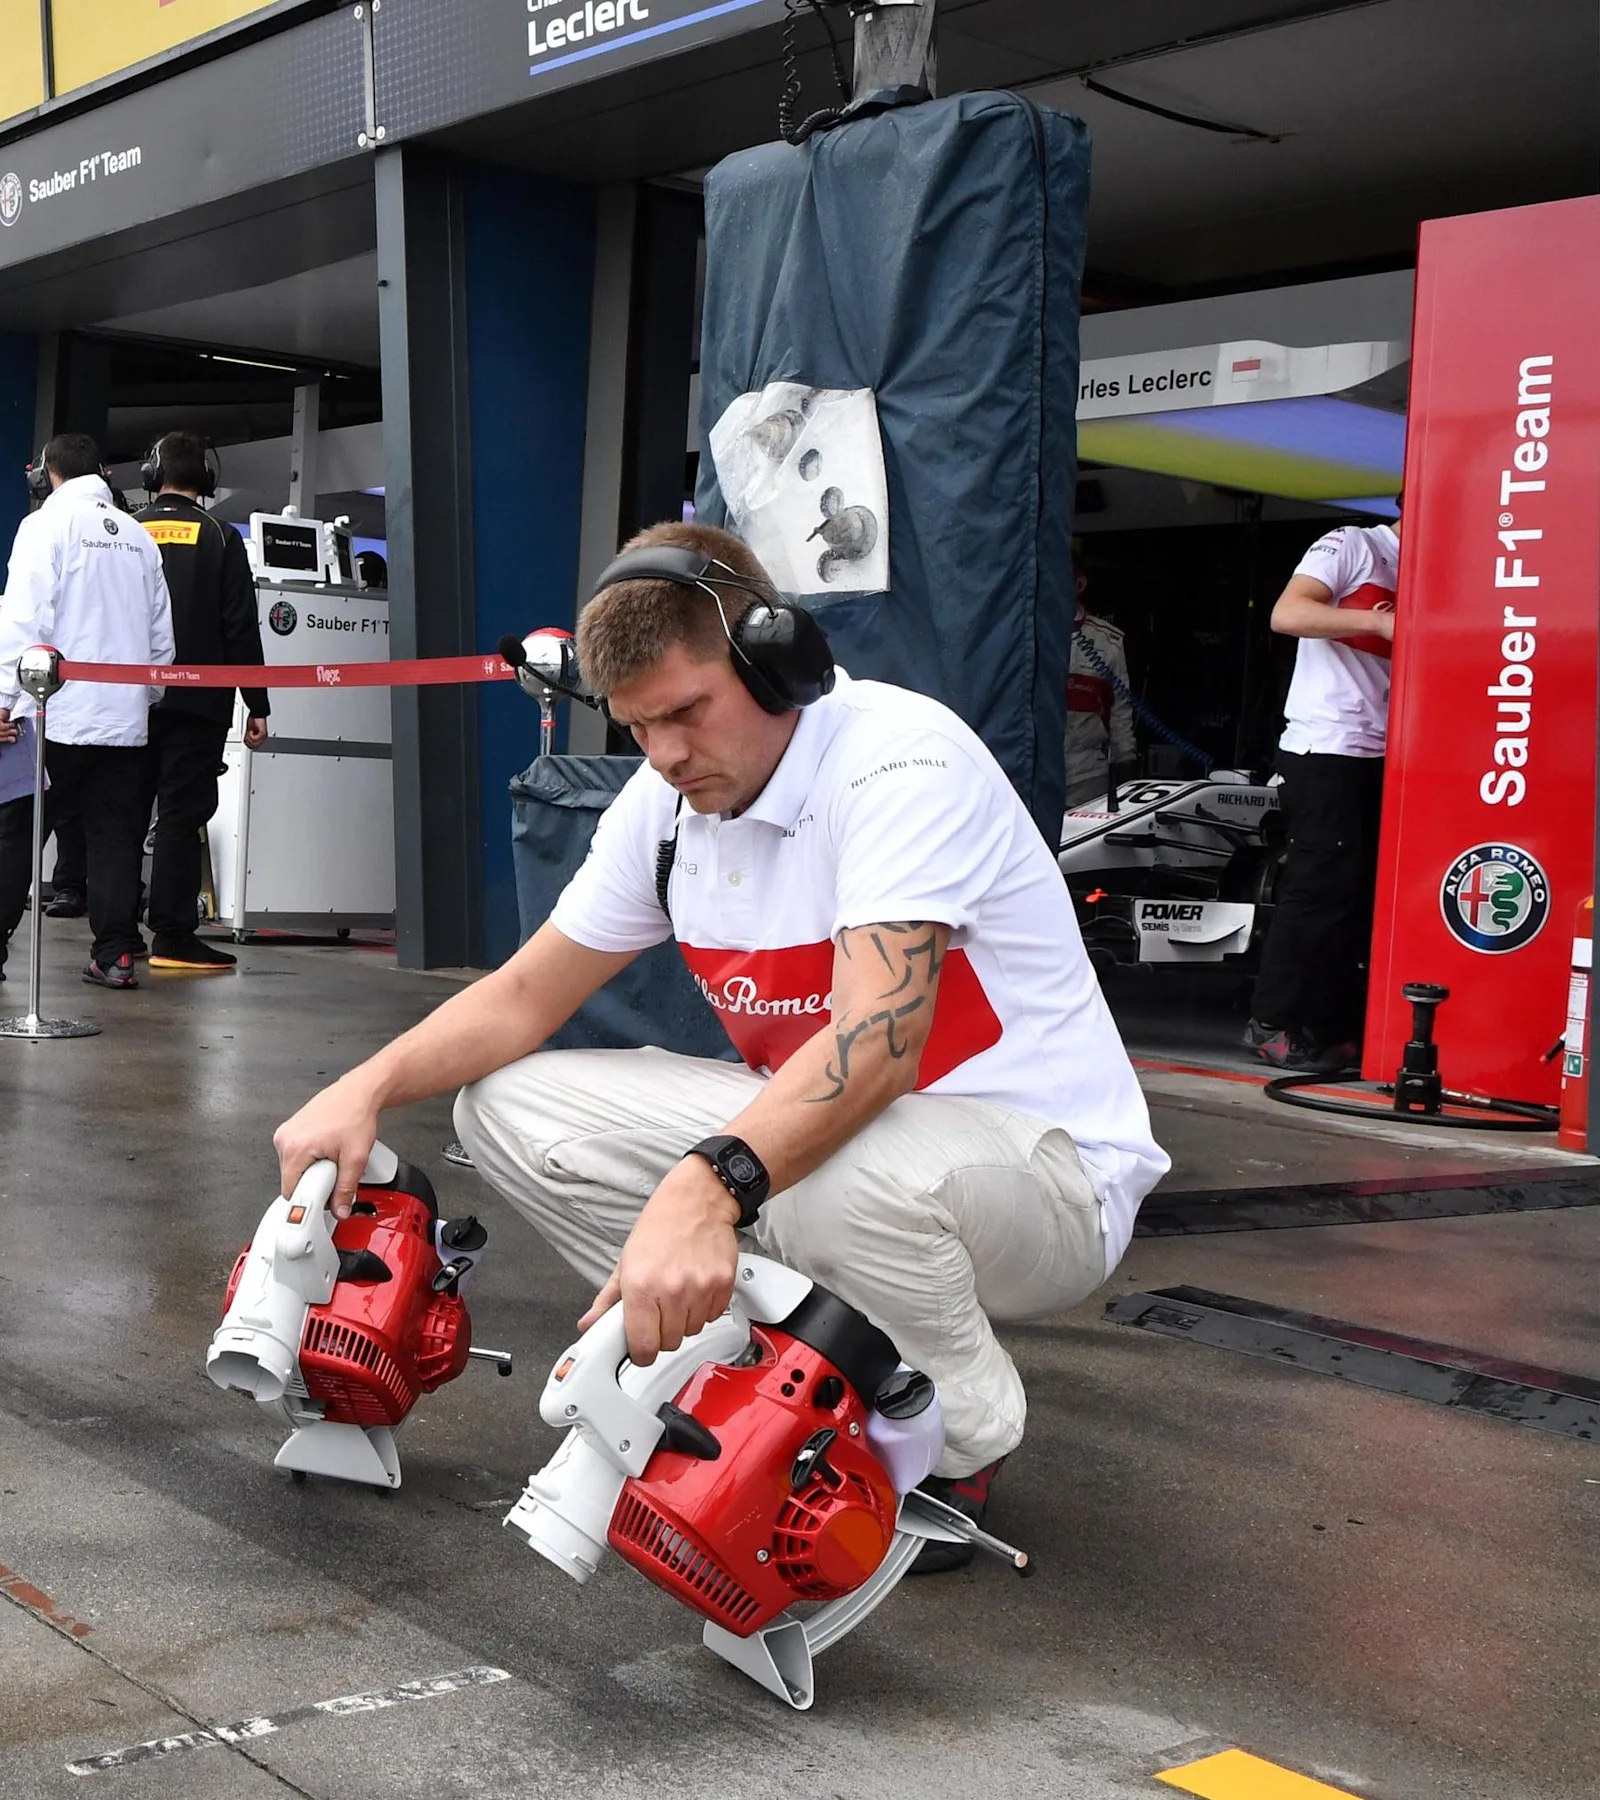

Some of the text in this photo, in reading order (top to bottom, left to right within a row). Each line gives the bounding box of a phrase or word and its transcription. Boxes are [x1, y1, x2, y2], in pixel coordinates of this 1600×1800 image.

[527, 0, 649, 57] Leclerc
[29, 170, 77, 203] Sauber
[101, 146, 142, 177] Team
[1080, 369, 1212, 400] rles Leclerc
[1500, 355, 1554, 505] Team
[147, 526, 191, 540] RELLI
[82, 539, 112, 550] Sauber
[126, 543, 144, 554] Team
[306, 614, 357, 632] Sauber
[1479, 606, 1537, 807] Sauber
[912, 758, 948, 769] MILLE
[1217, 793, 1266, 807] RICHARD
[1446, 848, 1546, 904] ALFA ROMEO
[1141, 903, 1204, 921] POWER
